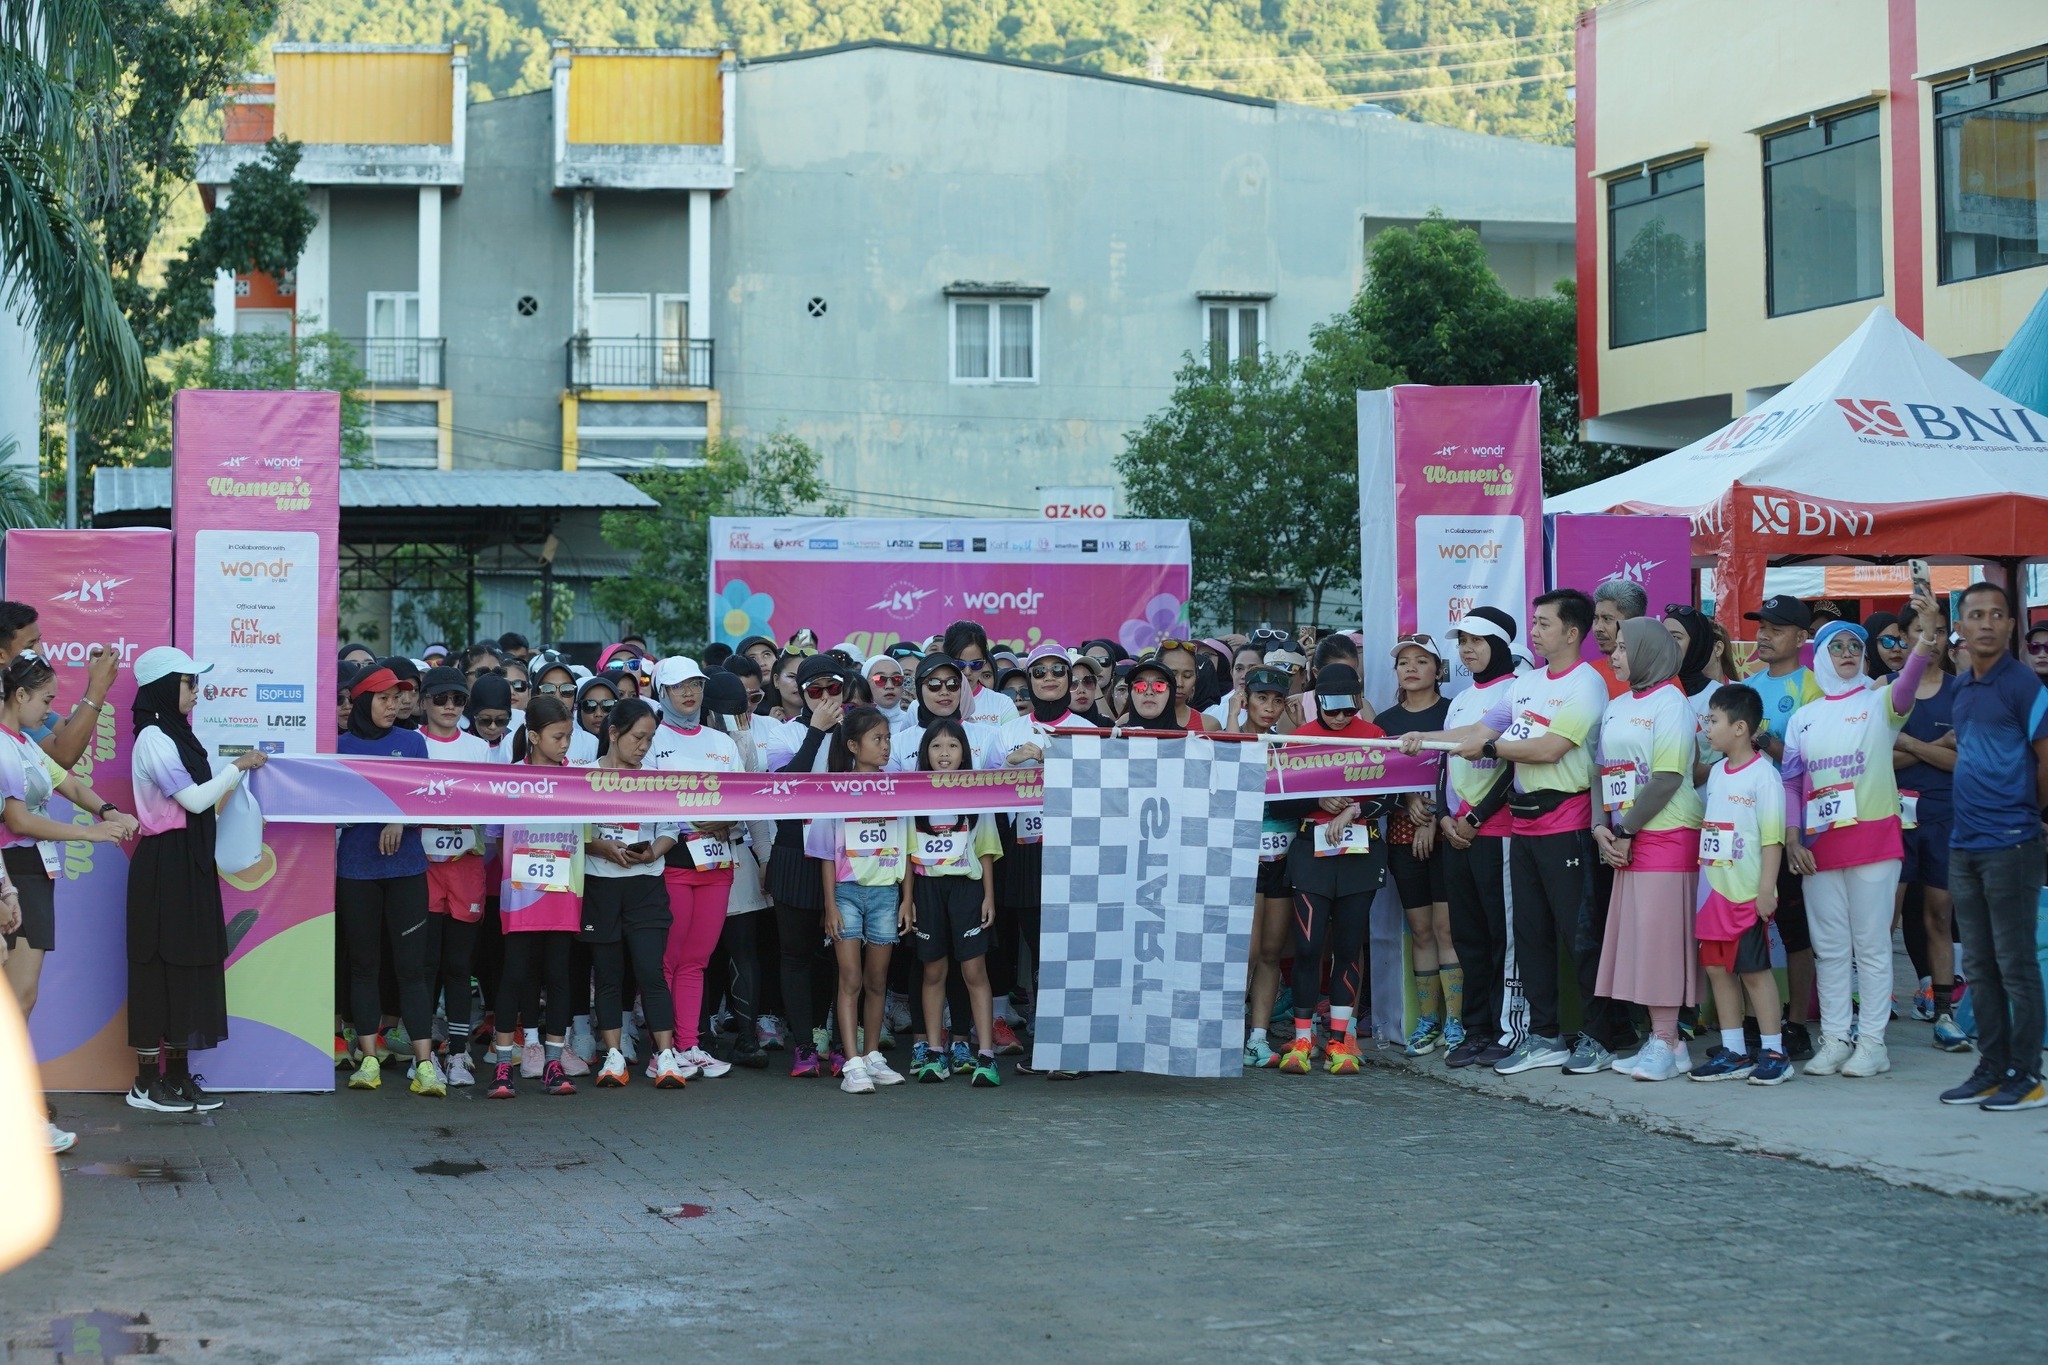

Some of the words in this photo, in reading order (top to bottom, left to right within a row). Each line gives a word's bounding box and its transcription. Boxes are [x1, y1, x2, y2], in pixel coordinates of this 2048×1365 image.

[1732, 401, 1823, 449] BNI
[1904, 403, 2047, 443] BNI
[1858, 436, 1905, 447] Melayani
[1471, 444, 1505, 455] wondr
[264, 456, 304, 467] wondr
[1423, 463, 1514, 484] Women's
[207, 476, 312, 497] Women's
[1796, 500, 1874, 536] BNI
[1438, 540, 1502, 559] wondr
[221, 558, 294, 578] wondr
[963, 587, 1044, 609] wondr
[1449, 597, 1473, 610] City
[231, 617, 259, 632] City
[230, 631, 281, 645] Market
[220, 687, 248, 697] KFC
[259, 689, 302, 700] ISOPLUS
[1266, 746, 1386, 771] Women's
[488, 778, 558, 794] wondr
[585, 771, 722, 793] Women's
[831, 776, 899, 793] wondr
[1610, 781, 1627, 796] 102
[1819, 800, 1841, 818] 487
[435, 836, 463, 849] 670
[512, 830, 579, 845] Women's
[859, 829, 887, 843] 650
[1262, 834, 1288, 850] 583
[703, 843, 724, 857] 502
[925, 839, 953, 853] 629
[528, 863, 554, 878] 613
